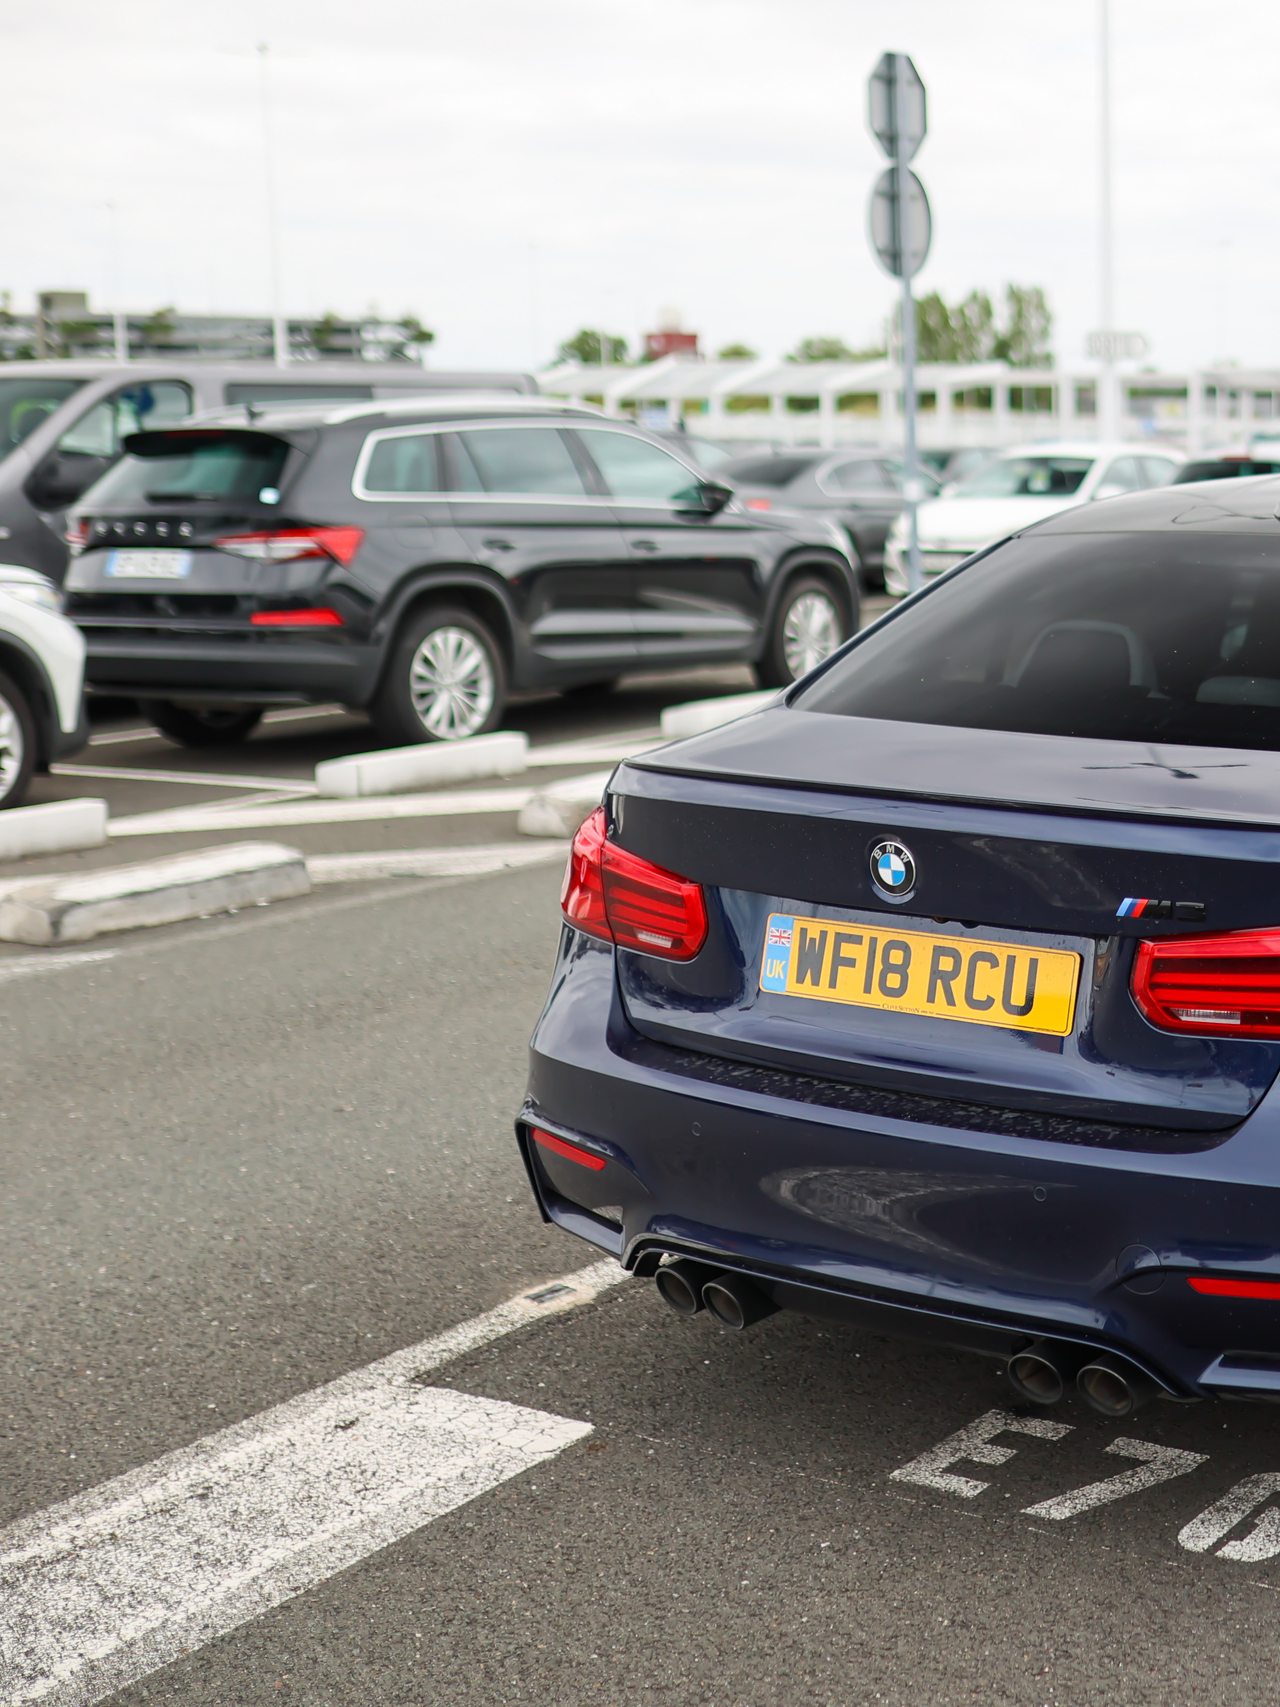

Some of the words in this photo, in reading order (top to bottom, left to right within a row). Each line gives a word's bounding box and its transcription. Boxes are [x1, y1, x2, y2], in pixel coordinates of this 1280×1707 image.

[873, 844, 910, 863] BMW
[766, 959, 784, 979] UK
[795, 927, 911, 998] WF18
[926, 944, 1039, 1016] RCU
